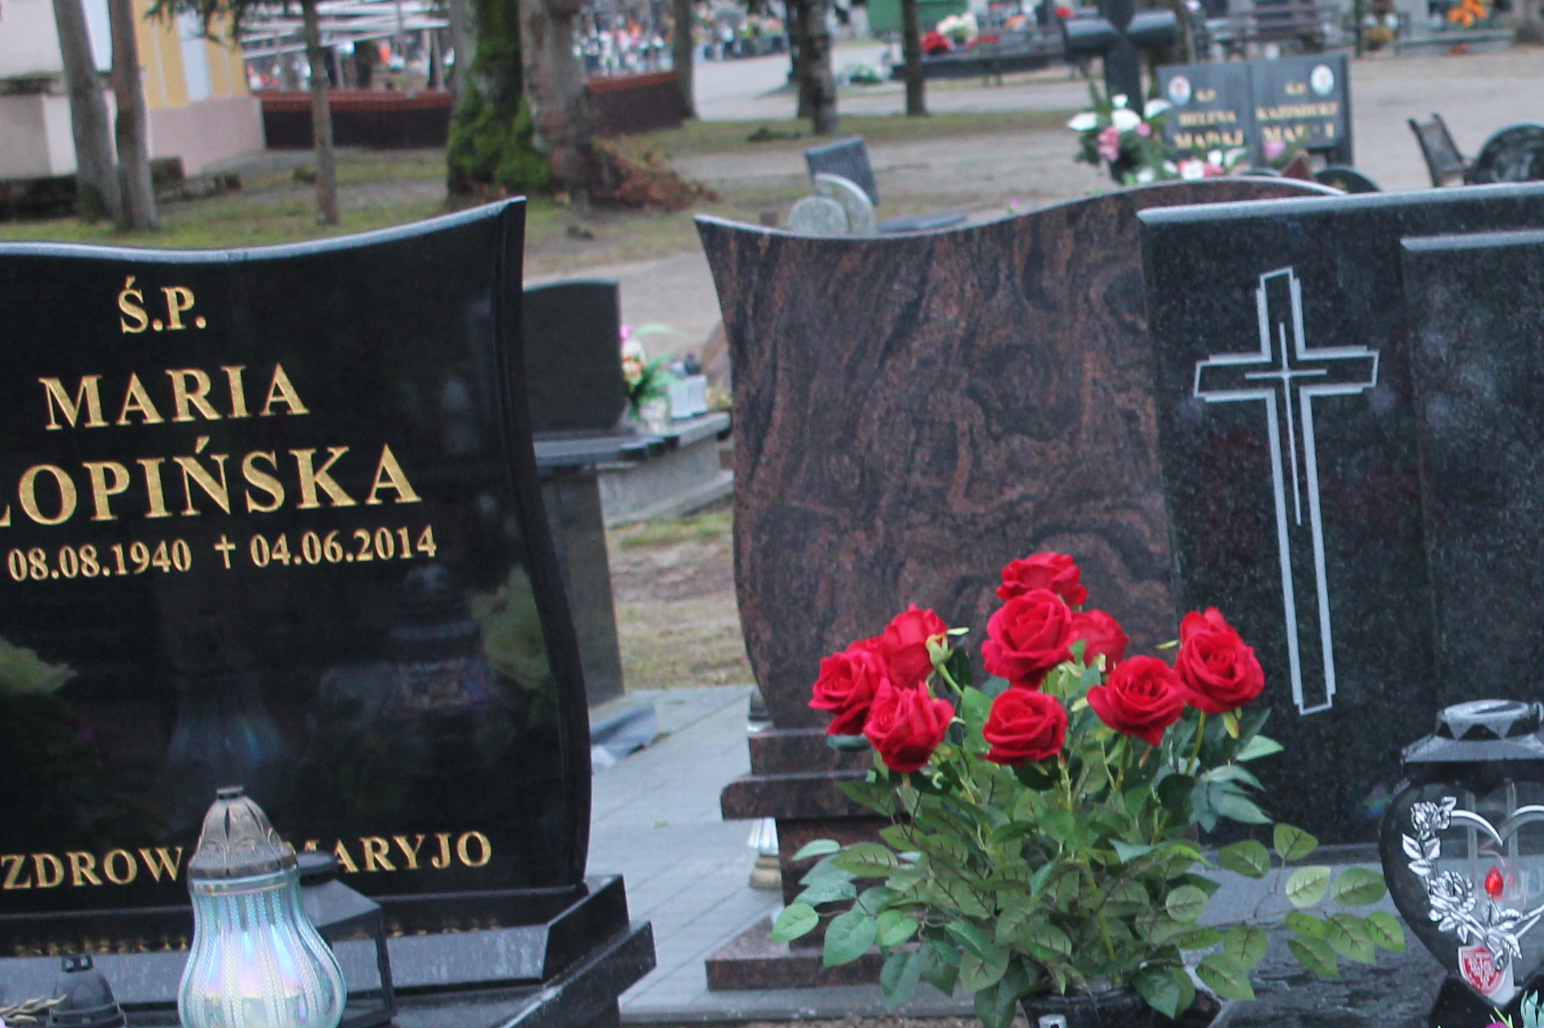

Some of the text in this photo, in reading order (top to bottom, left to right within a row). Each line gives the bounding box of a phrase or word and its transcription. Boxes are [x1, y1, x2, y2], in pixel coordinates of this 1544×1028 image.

[117, 275, 208, 334] Ś.P.
[38, 361, 311, 431] MARIA
[0, 436, 422, 529] OPIŃSKA
[7, 524, 438, 583] 08.08.1940 04.06.2014
[1, 829, 493, 890] ZDROW ARYJO
